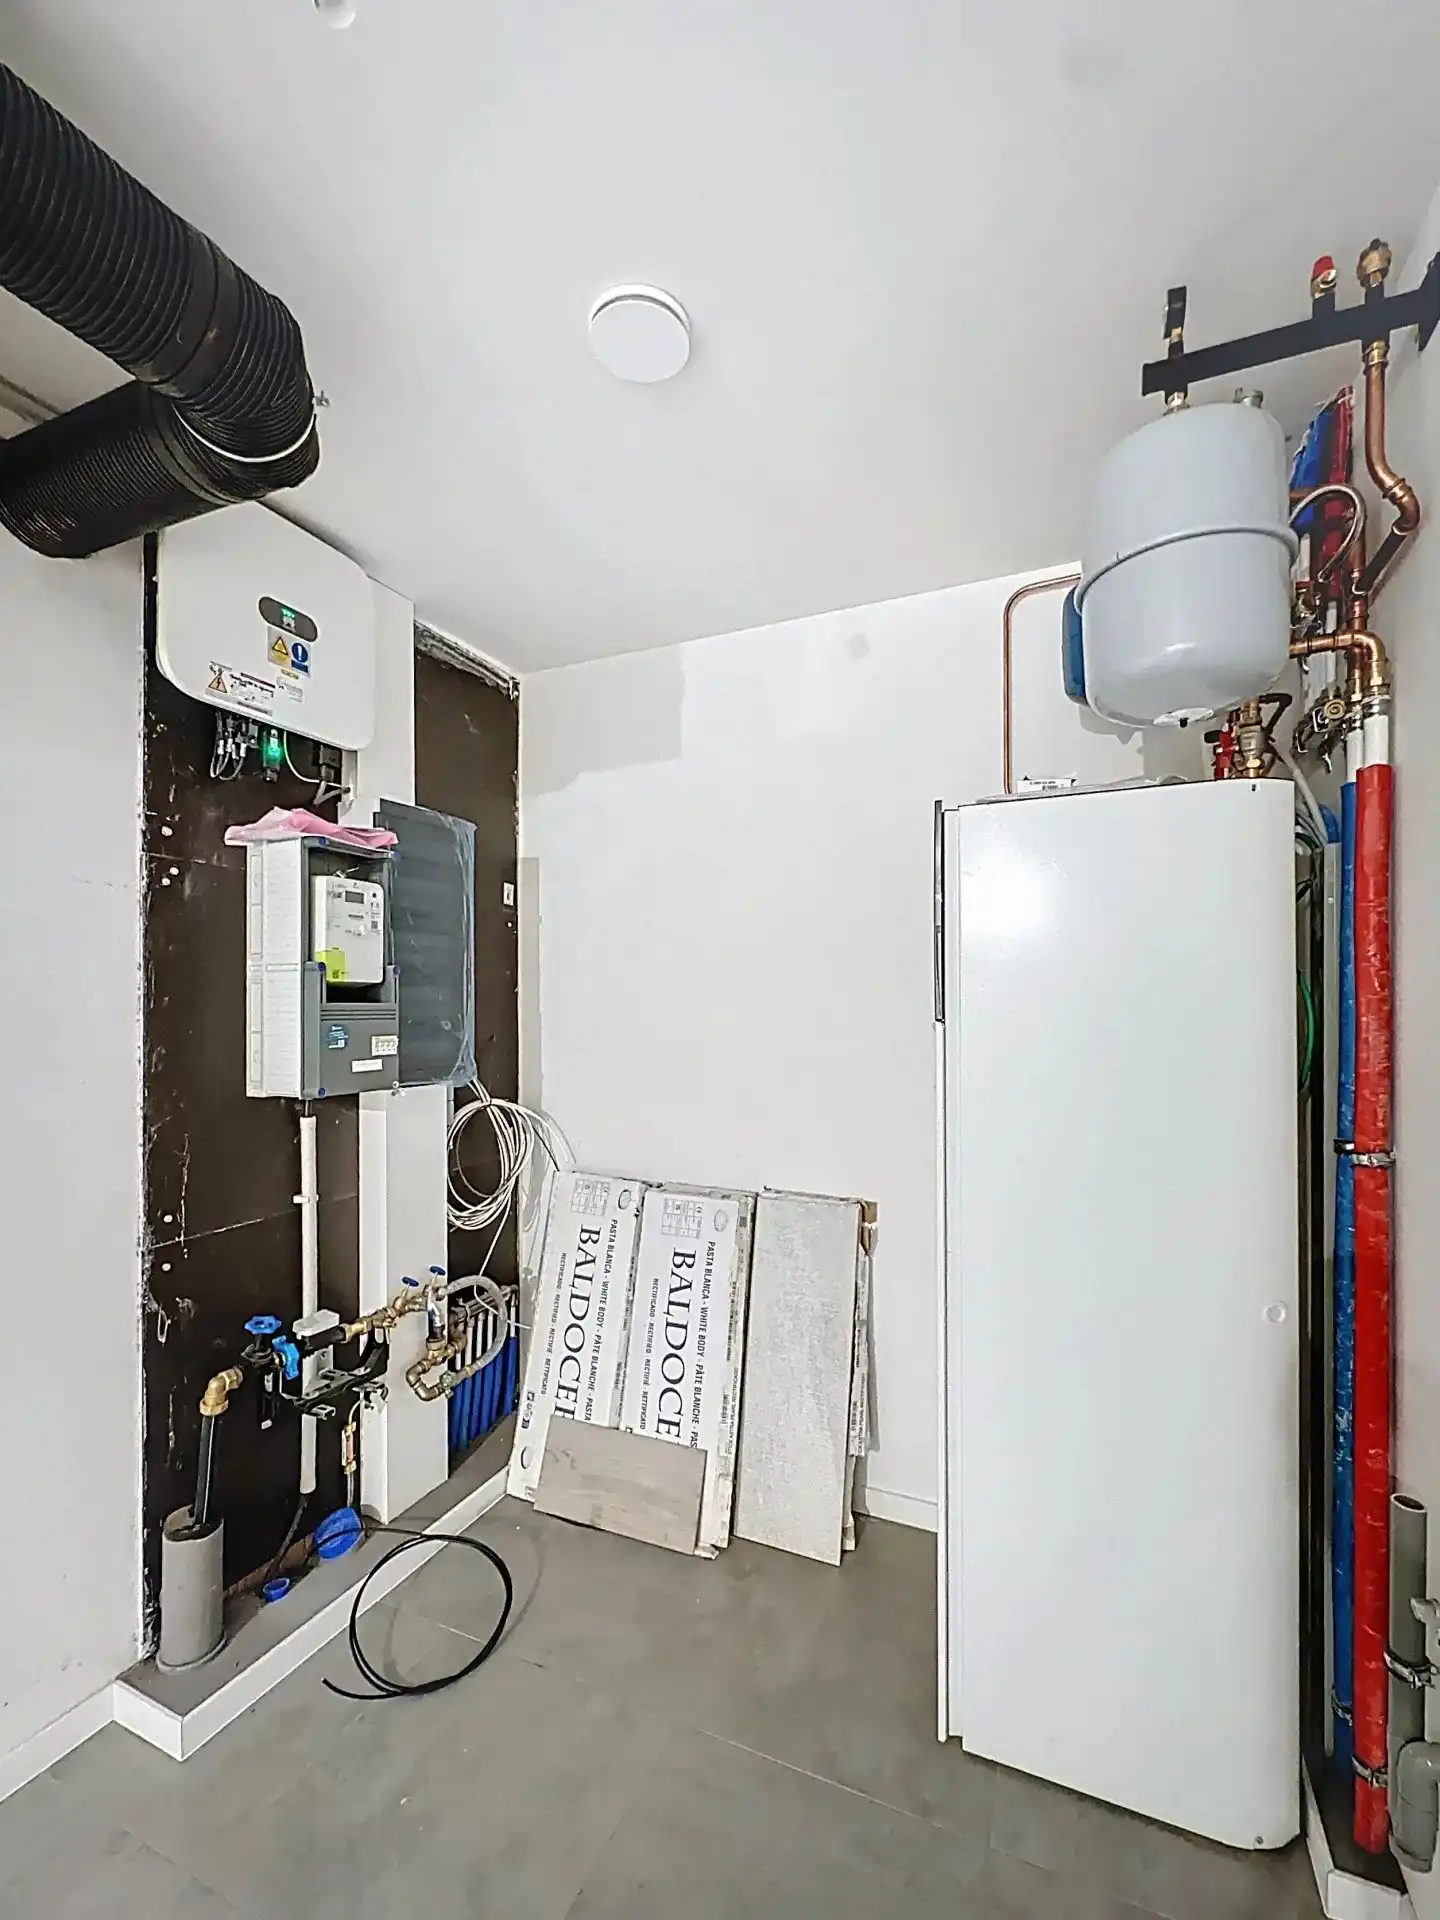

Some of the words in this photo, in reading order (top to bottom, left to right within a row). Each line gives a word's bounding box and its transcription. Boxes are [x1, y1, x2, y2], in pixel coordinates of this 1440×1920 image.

[607, 1219, 618, 1243] PASTA
[603, 1244, 615, 1274] BLANCA
[705, 1240, 716, 1266] PASTA
[556, 1252, 567, 1290] RECTIFICADO
[701, 1268, 712, 1301] BLANCA
[599, 1280, 610, 1305] WHITE
[648, 1278, 659, 1317] RECTIFICADO
[551, 1293, 561, 1324] RECTIFIED
[596, 1306, 606, 1329] BODY
[698, 1306, 709, 1333] WHITE
[645, 1322, 655, 1354] RECTIFIED
[655, 1247, 697, 1439] BALDOCE
[696, 1335, 707, 1357] BODY
[540, 1358, 551, 1395] RETTIFICATO
[588, 1355, 599, 1392] BLANCHE
[584, 1396, 594, 1421] PASTA
[639, 1390, 649, 1430] RETTIFICATO
[691, 1386, 701, 1425] BLANCHE
